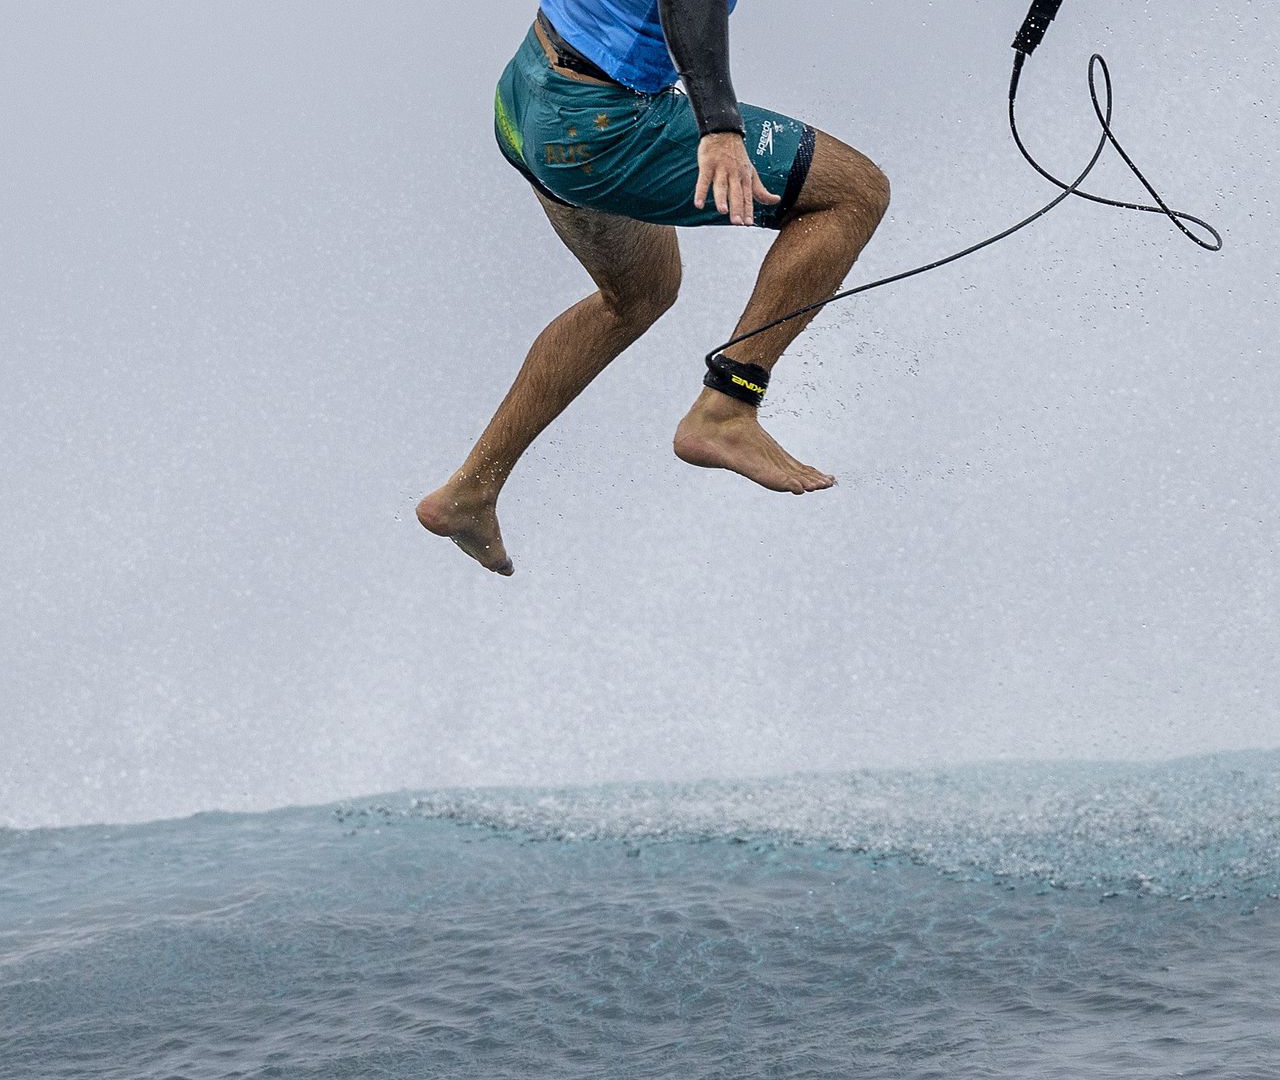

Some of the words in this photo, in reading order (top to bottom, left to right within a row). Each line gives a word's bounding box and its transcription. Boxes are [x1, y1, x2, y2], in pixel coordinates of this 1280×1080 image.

[756, 120, 771, 156] speedo
[545, 143, 593, 165] AUS
[731, 374, 768, 395] AKINE
